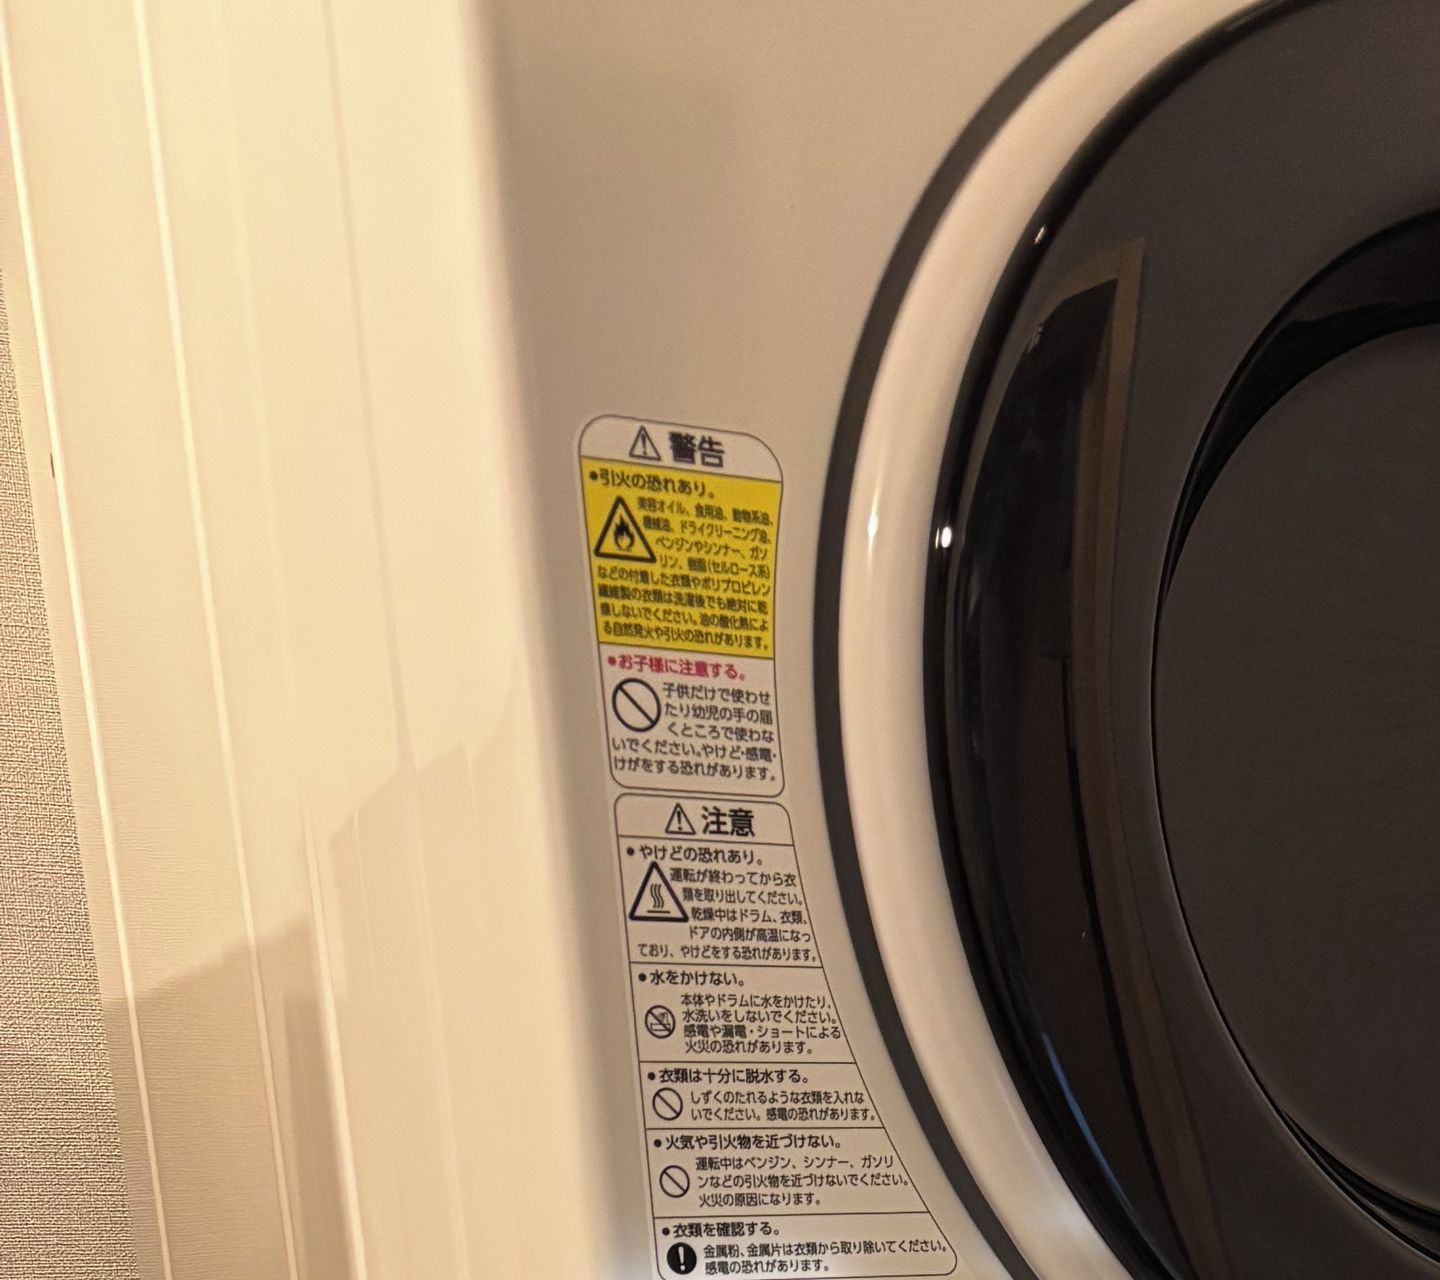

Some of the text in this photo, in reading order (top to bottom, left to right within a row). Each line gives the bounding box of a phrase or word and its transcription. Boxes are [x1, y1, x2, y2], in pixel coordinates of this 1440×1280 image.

[668, 431, 725, 468] 警告
[702, 806, 755, 837] 注意
[639, 846, 763, 866] やけどの恐れあり。
[650, 970, 744, 986] 水をかけない。
[659, 1069, 809, 1084] 衣類は十分に脱水する。
[673, 1221, 780, 1238] 衣類を確認する。
